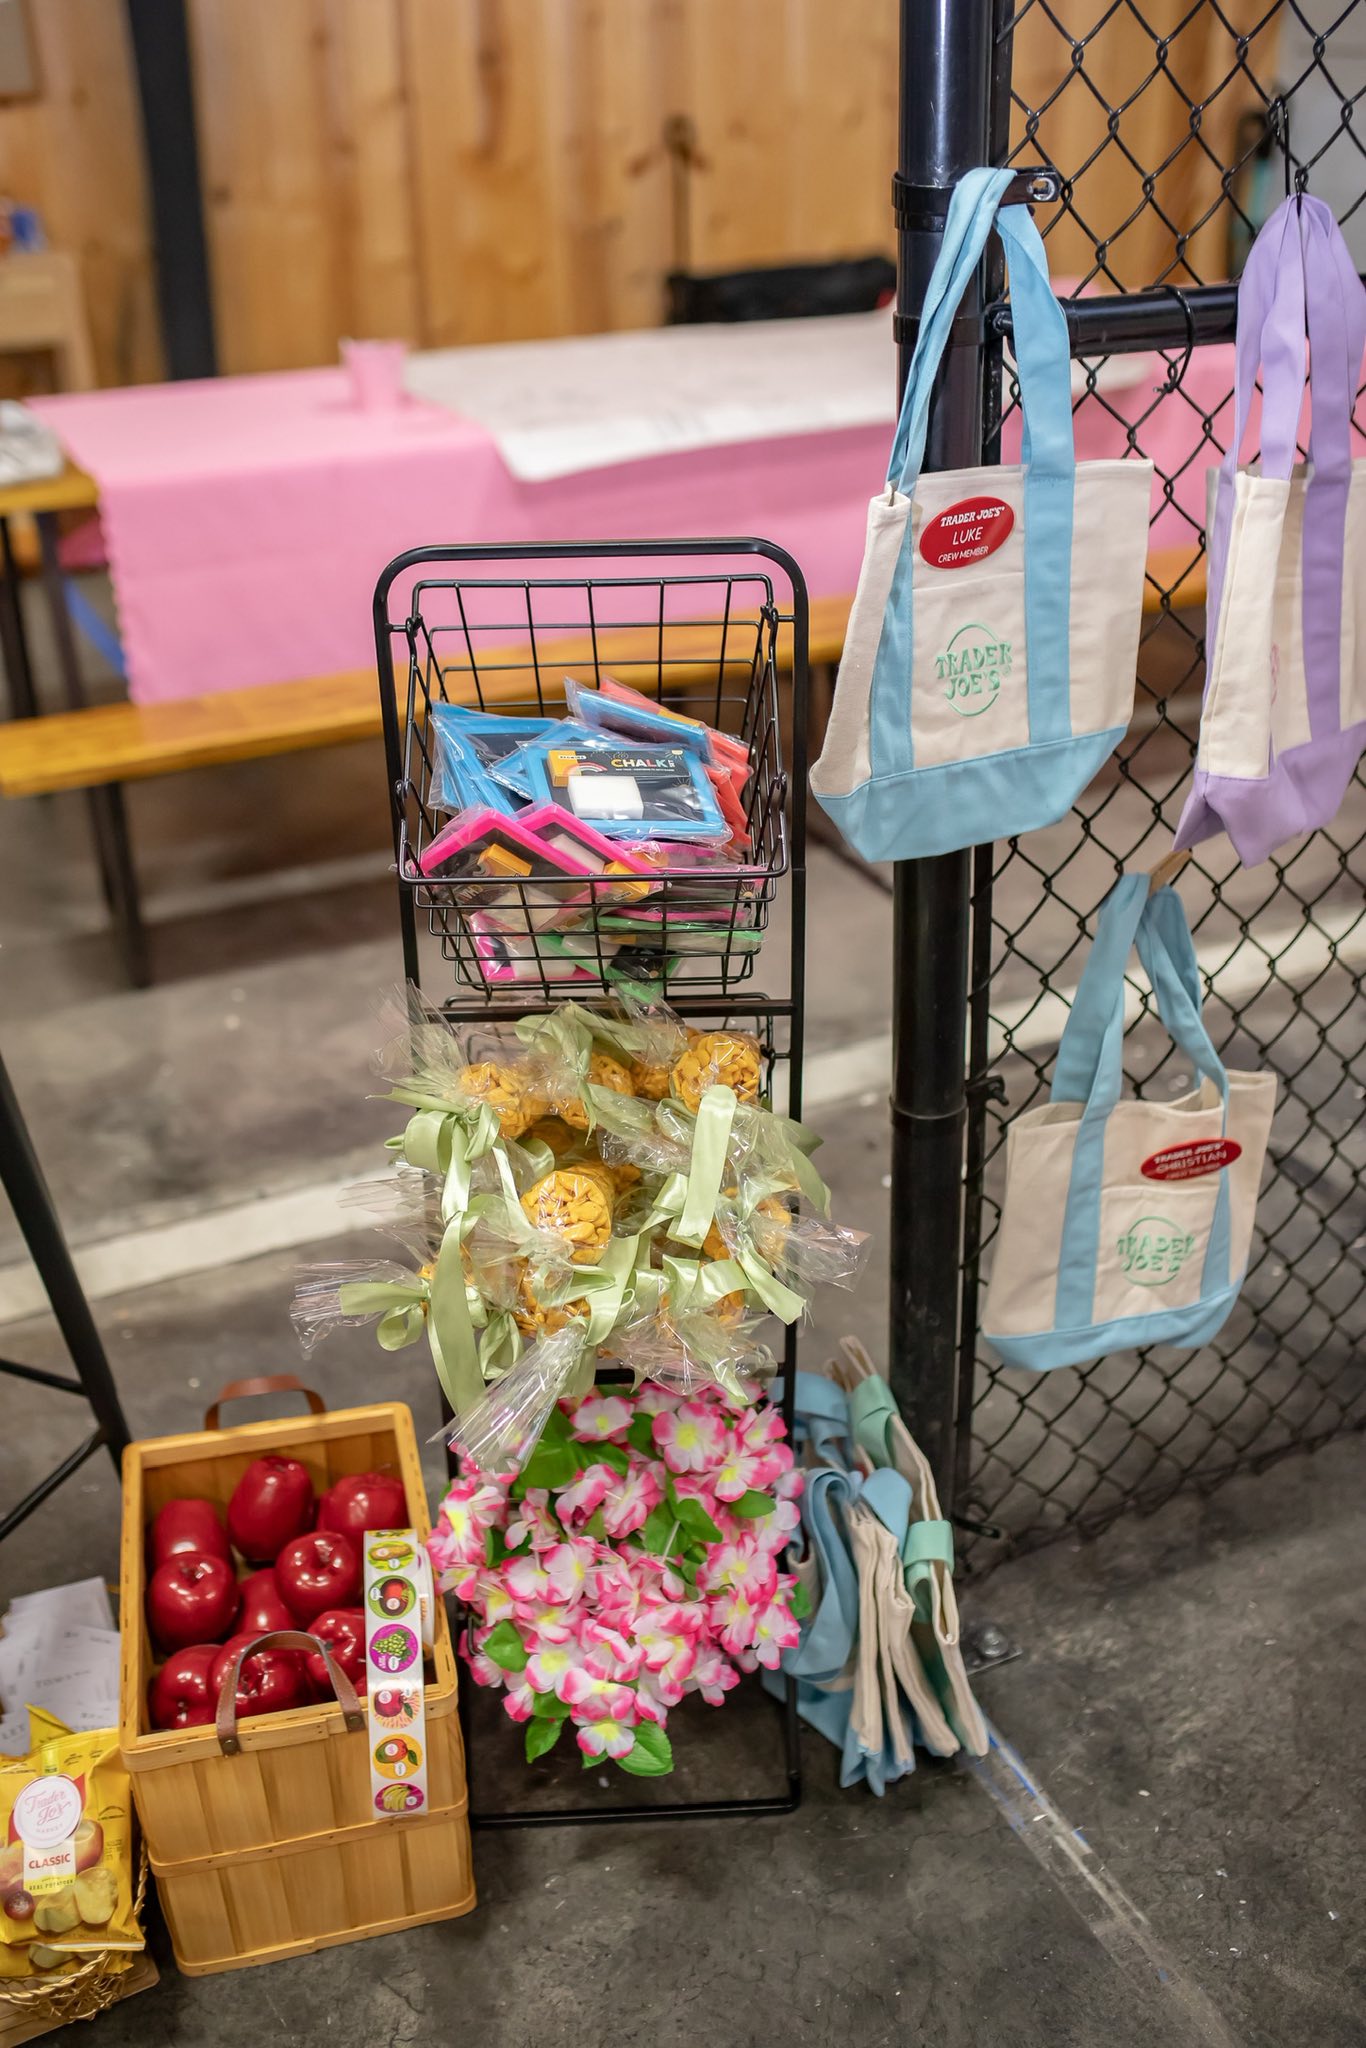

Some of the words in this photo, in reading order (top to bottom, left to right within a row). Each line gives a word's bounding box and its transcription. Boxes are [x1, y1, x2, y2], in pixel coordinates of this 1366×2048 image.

[940, 511, 976, 527] TRADER
[952, 526, 984, 546] LUKE
[937, 552, 960, 564] CREW
[959, 545, 989, 560] MEMBER
[934, 642, 1011, 680] TRADER
[943, 669, 1001, 701] JOE'S
[611, 758, 668, 768] CHALK
[1155, 1149, 1228, 1174] CHRISTIAN
[28, 1853, 71, 1869] CLASSIC
